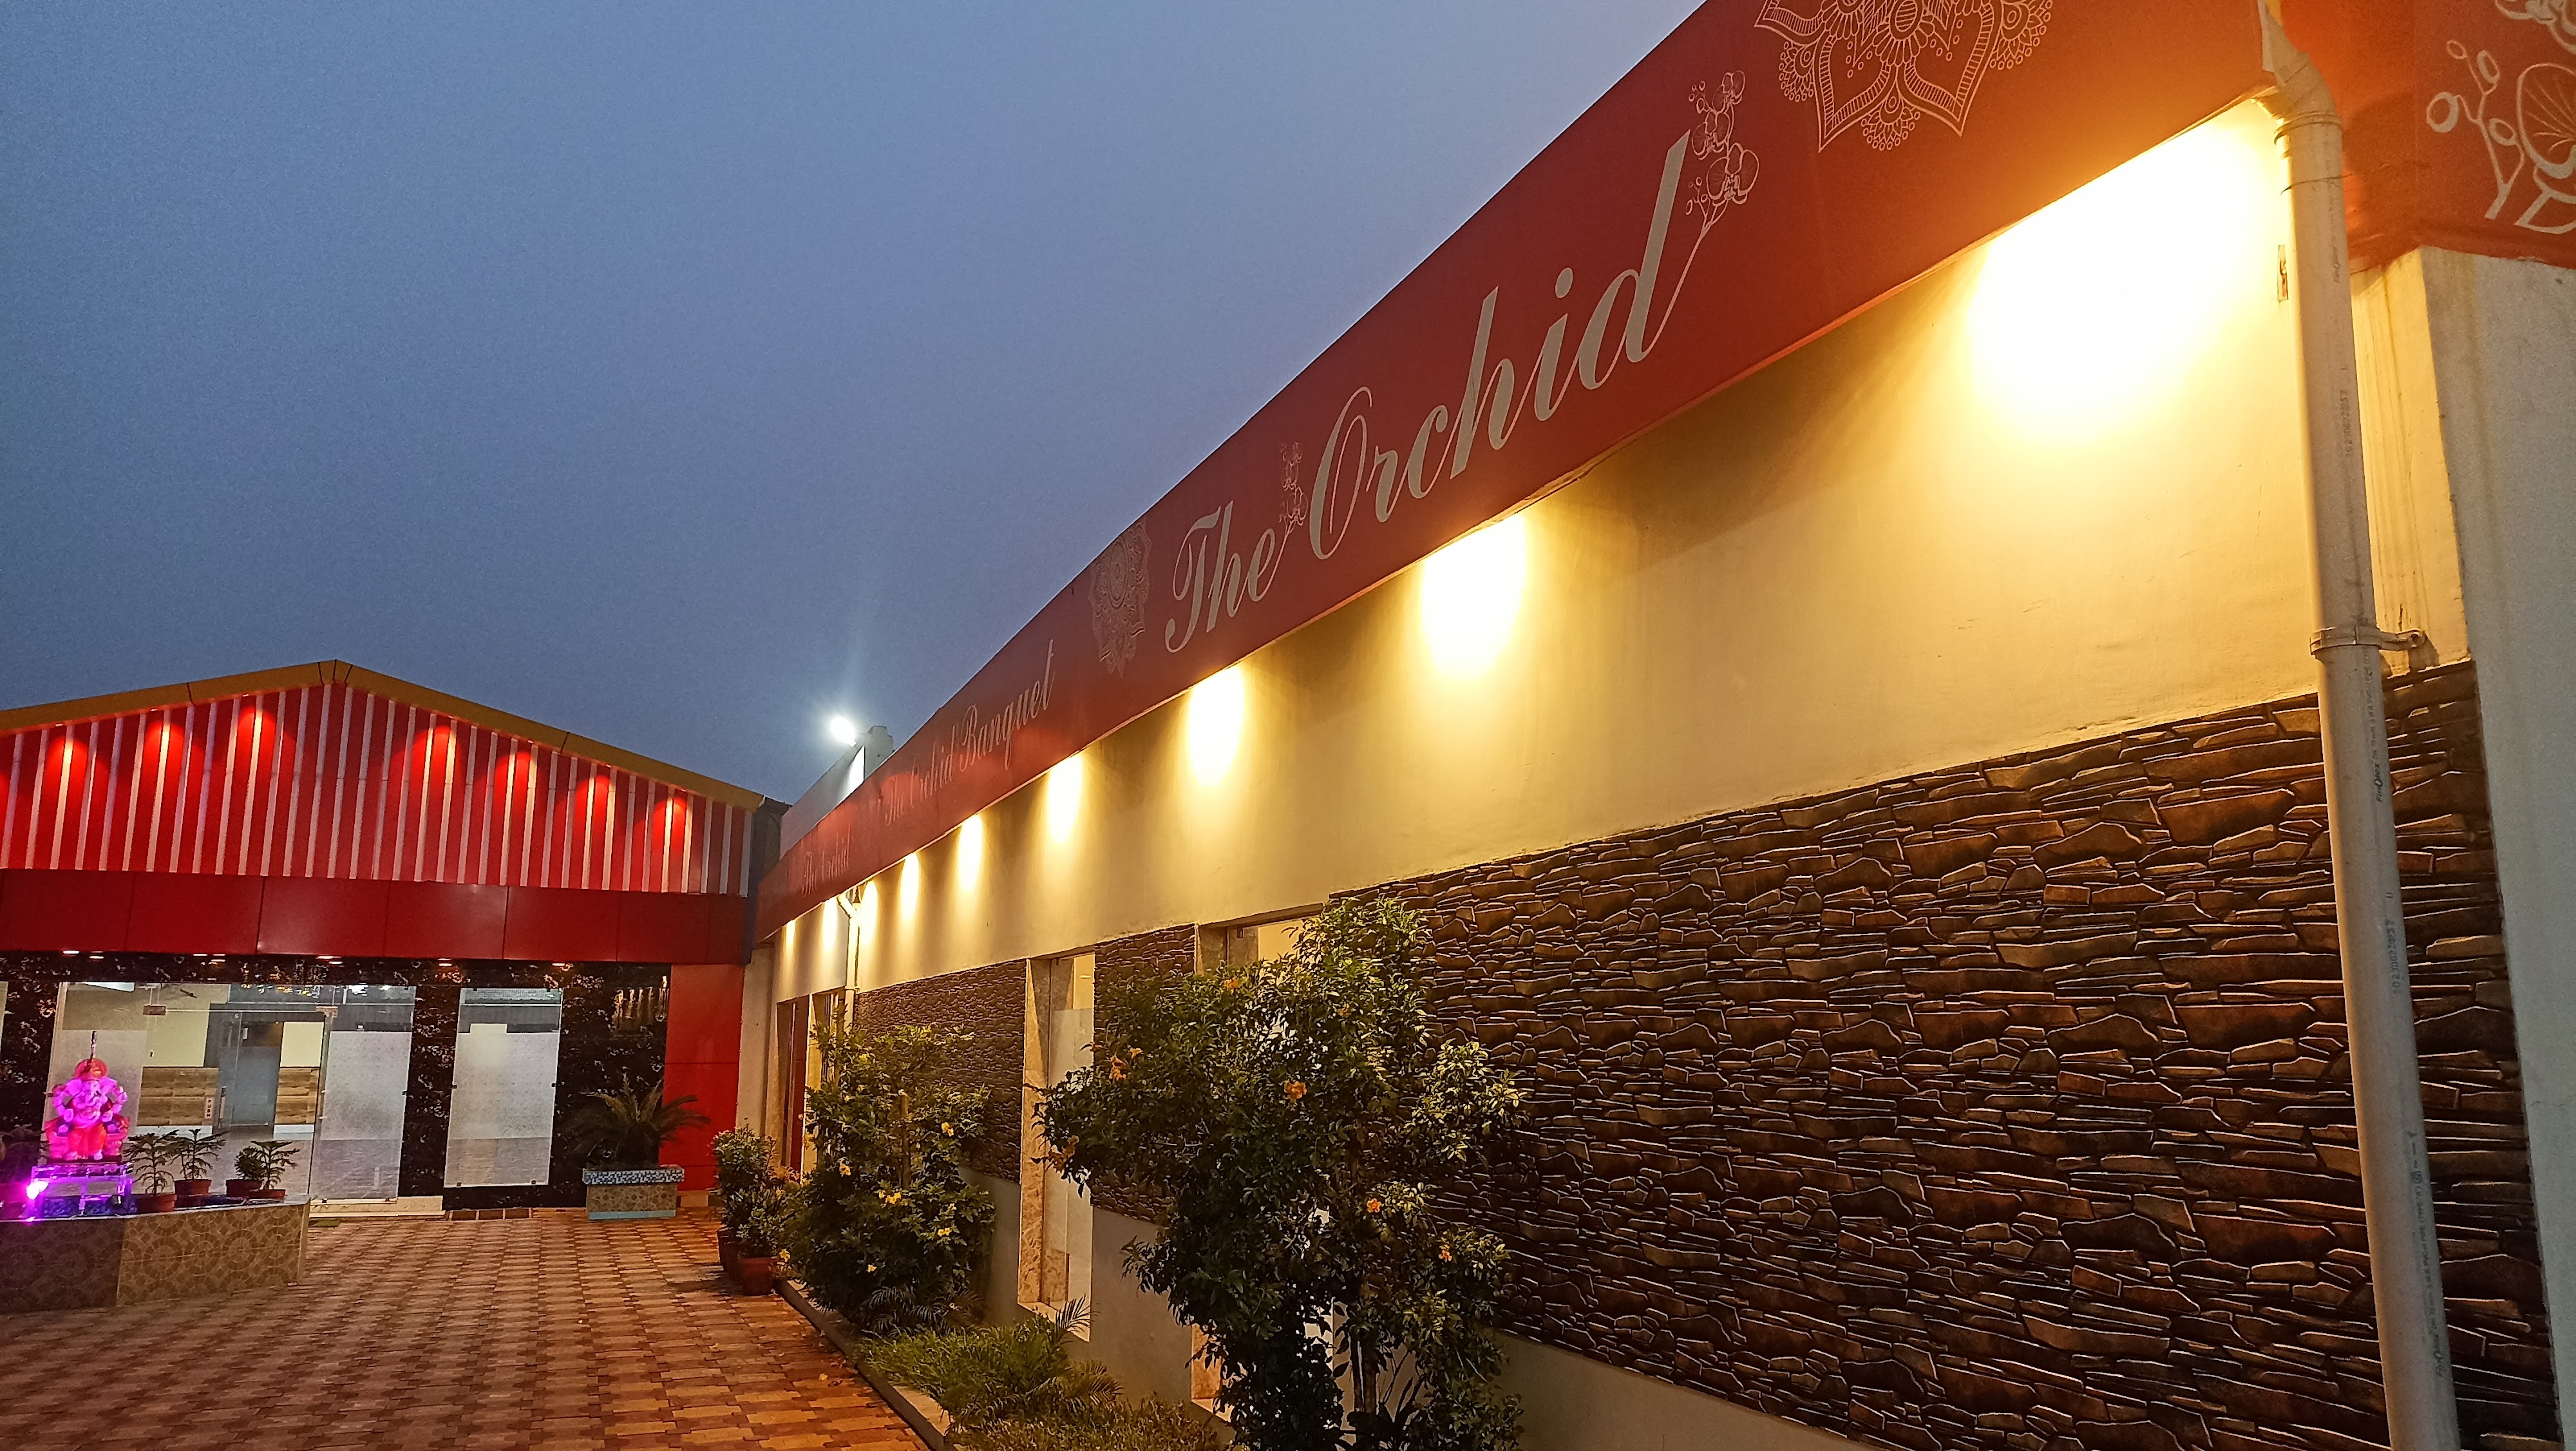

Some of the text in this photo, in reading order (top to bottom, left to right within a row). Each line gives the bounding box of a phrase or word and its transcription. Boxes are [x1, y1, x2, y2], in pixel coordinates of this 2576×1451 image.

[1165, 129, 1695, 652] The Orchid
[910, 724, 956, 808] Orchid
[959, 639, 1056, 771] Banquet
